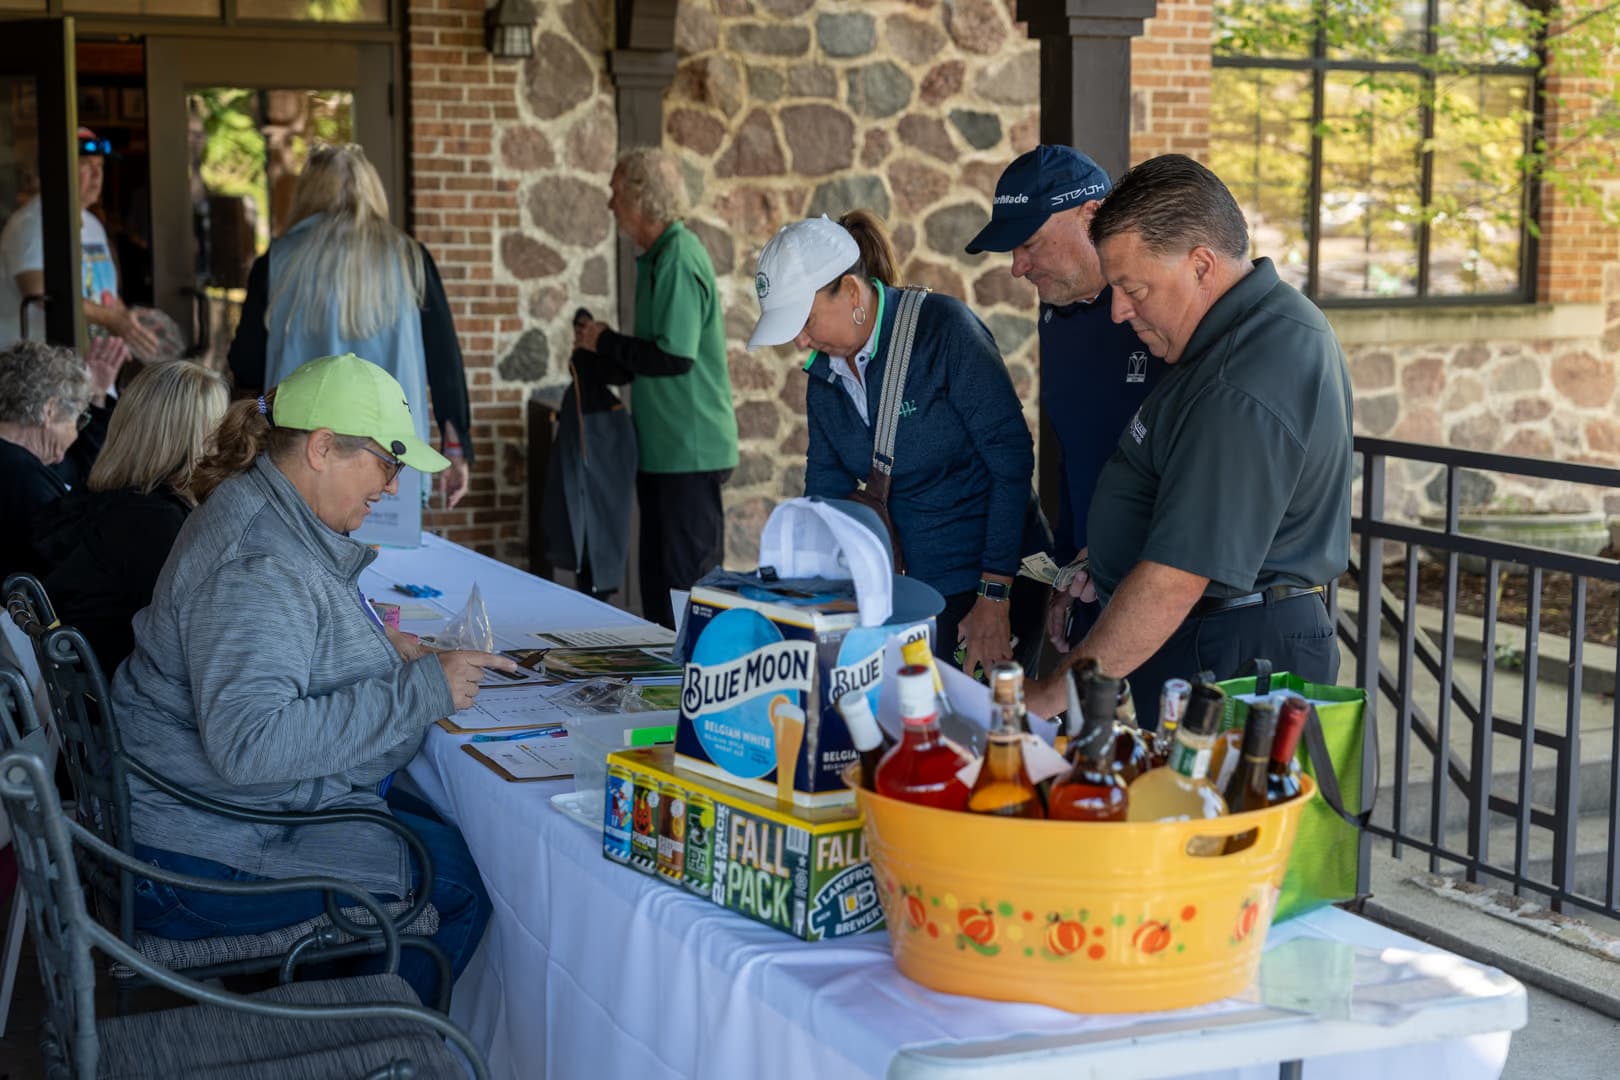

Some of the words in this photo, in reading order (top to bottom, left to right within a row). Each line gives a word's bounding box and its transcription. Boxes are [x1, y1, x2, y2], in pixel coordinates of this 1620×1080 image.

[994, 193, 1029, 204] rMade
[1051, 183, 1105, 206] STEALTH
[684, 666, 742, 713] BLUE
[743, 649, 809, 692] MOON
[832, 658, 880, 700] BLUE
[704, 719, 741, 739] BELGIAN
[743, 731, 771, 749] WHITE
[823, 750, 859, 762] BELGIA
[714, 803, 727, 860] PACK
[731, 813, 790, 879] FALL
[816, 832, 870, 871] FALL
[712, 861, 727, 906] 24
[727, 860, 792, 928] PACK
[821, 866, 872, 905] LAKEFRO
